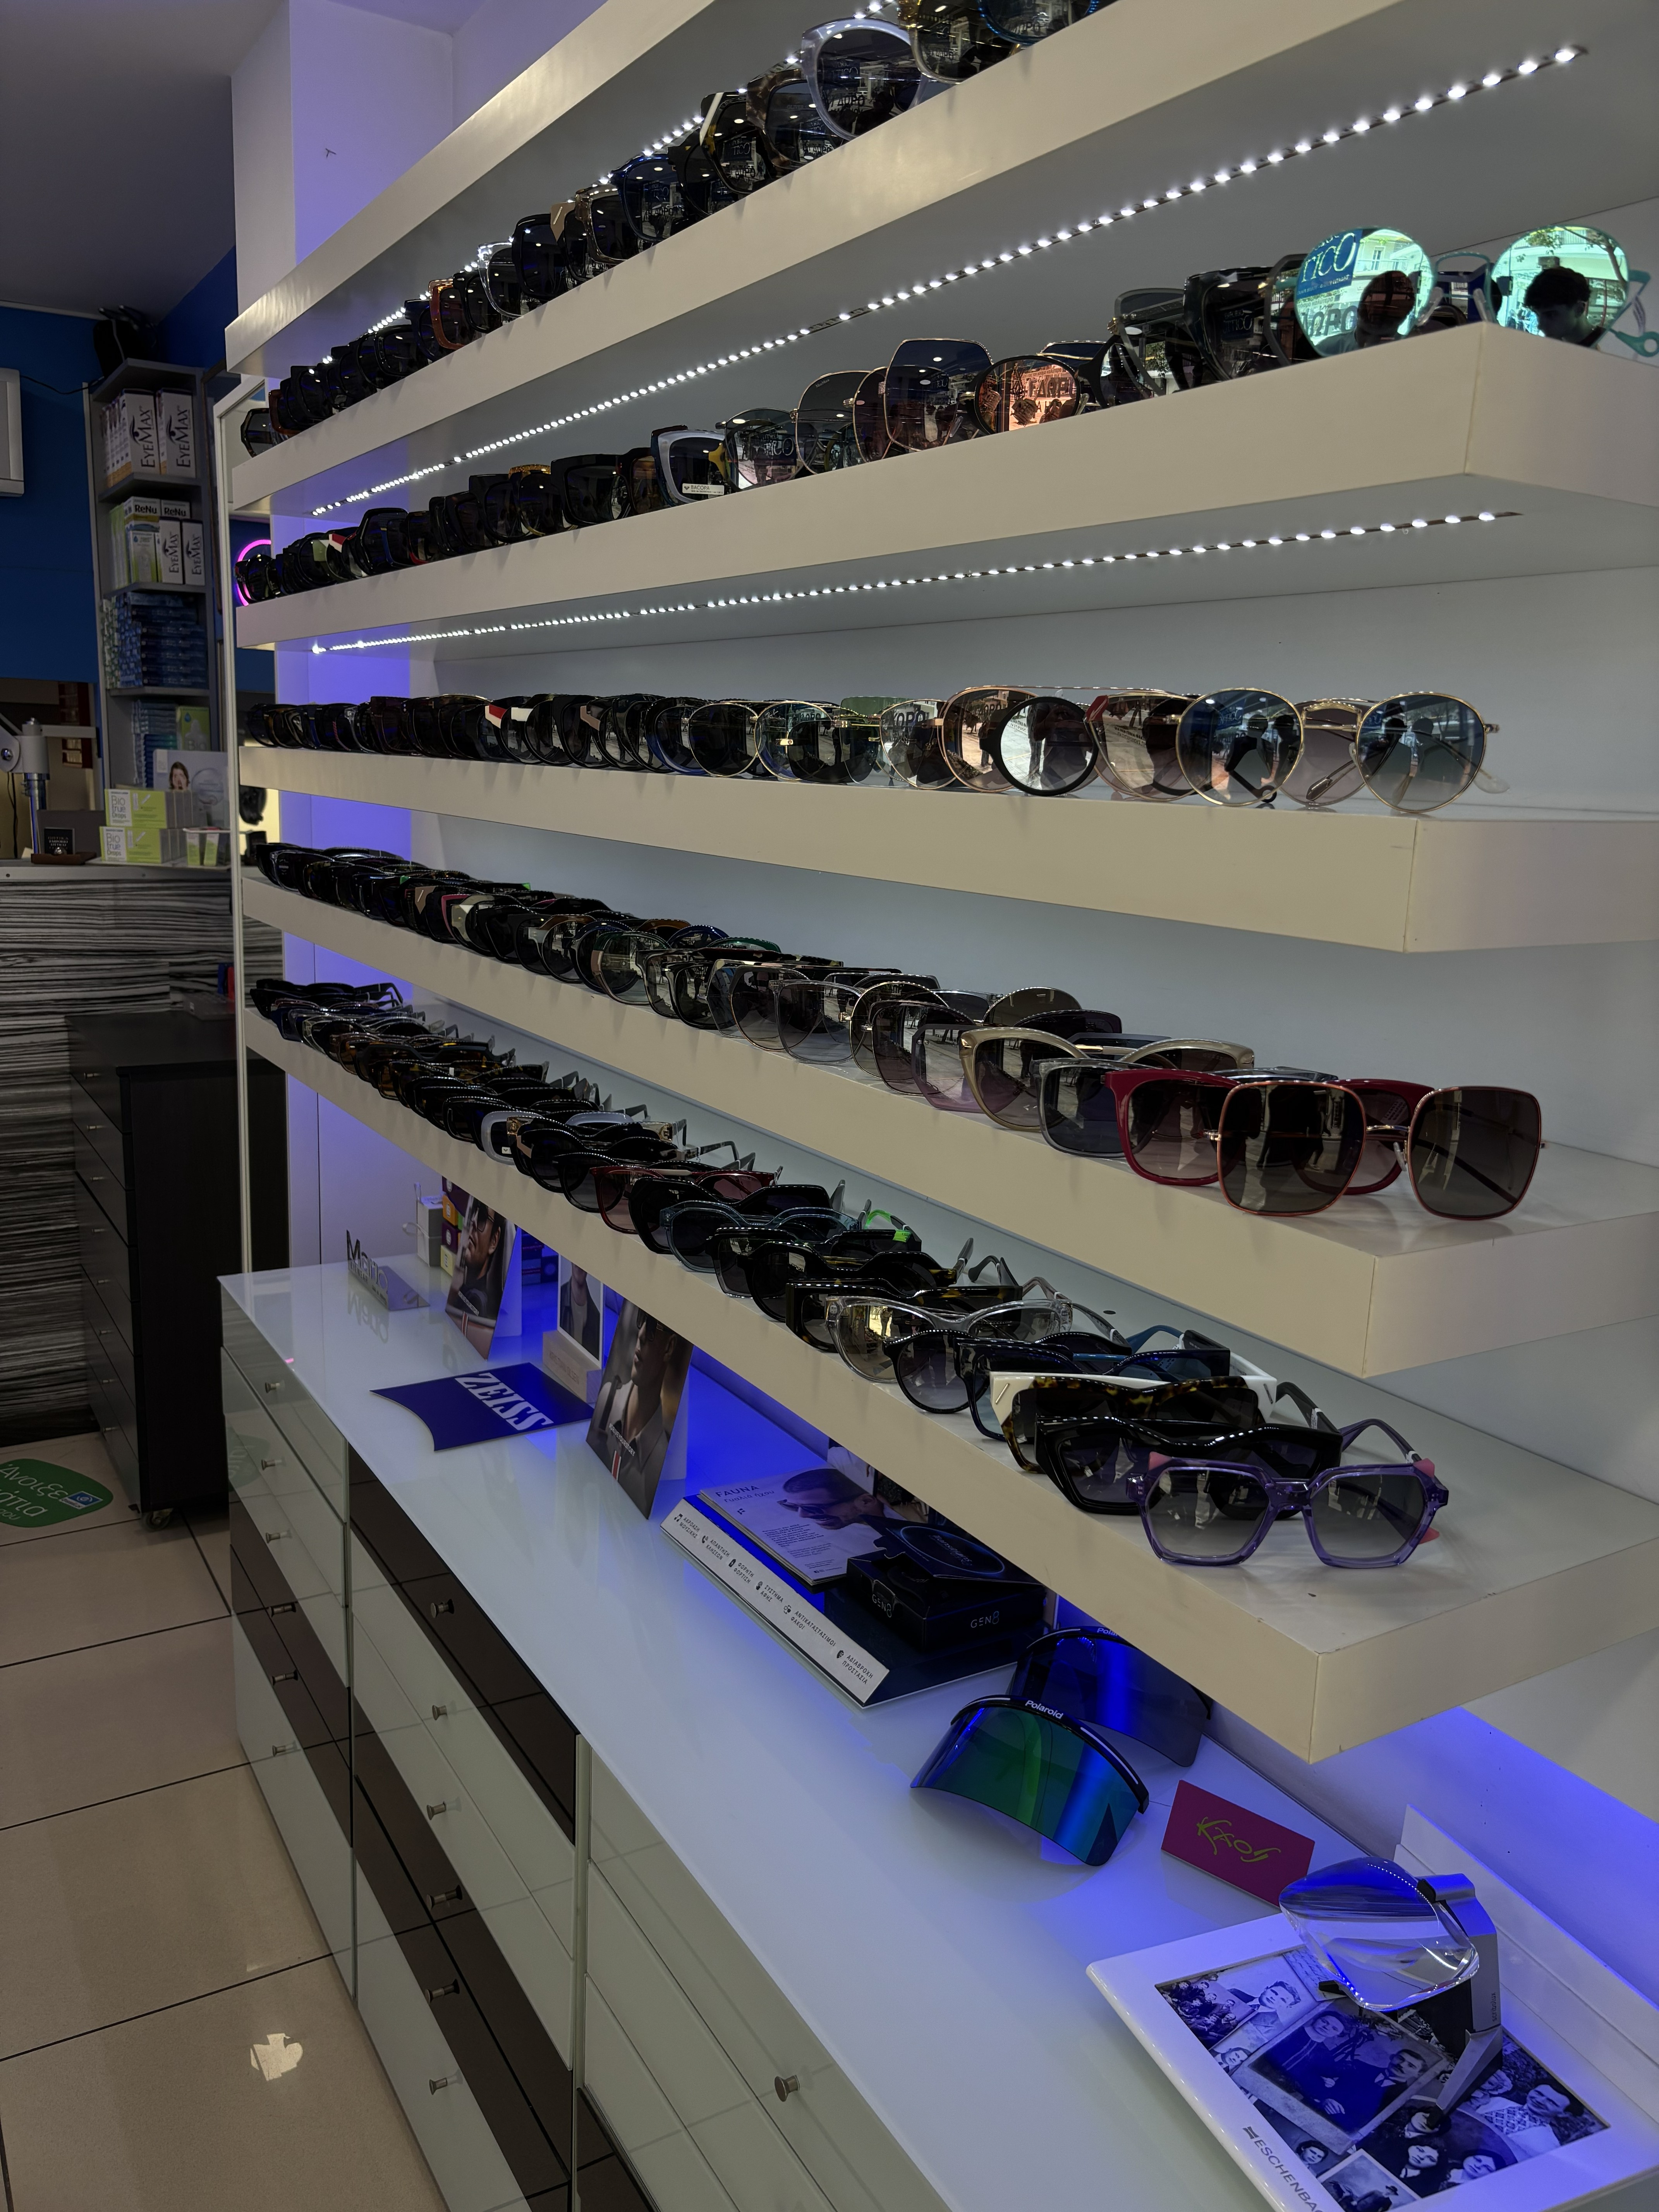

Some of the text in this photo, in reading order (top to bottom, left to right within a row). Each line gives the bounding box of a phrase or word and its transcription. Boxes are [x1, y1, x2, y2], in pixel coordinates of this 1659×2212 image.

[454, 1372, 554, 1431] ZEISS
[715, 1485, 760, 1497] FAUNA
[724, 1494, 753, 1503] Γυαλιά
[0, 1489, 49, 1517] άτια
[679, 1522, 699, 1539] ΜΟΥΣΙΚΗΣ
[683, 1517, 701, 1532] ΑΚΡΟΑΣΗ
[705, 1544, 724, 1561] ΚΛΗΣΕΩΝ
[709, 1539, 731, 1558] ΑΠΑΝΤΗΣΗ
[733, 1568, 752, 1584] ΦΟΡΤΙΣΗ
[738, 1562, 755, 1578] ΦΟΡΗΤΗ
[759, 1590, 773, 1603] ΑΦΗΣ
[764, 1584, 784, 1603] ΣΥΣΤΗΜΑ
[872, 1594, 892, 1618] GEN8
[790, 1616, 805, 1630] ΦΑΚΟΙ
[970, 1611, 1000, 1628] GEN8
[794, 1611, 836, 1647] ΑΝΤΙΚΑΤΑΣΤΑΣΙΜΟΙ
[842, 1660, 868, 1685] ΠΡΟΣΤΑΣΙΑ
[846, 1654, 874, 1679] ΑΔΙΑΒΡΟΧΗ
[1025, 1700, 1064, 1719] Polaroid
